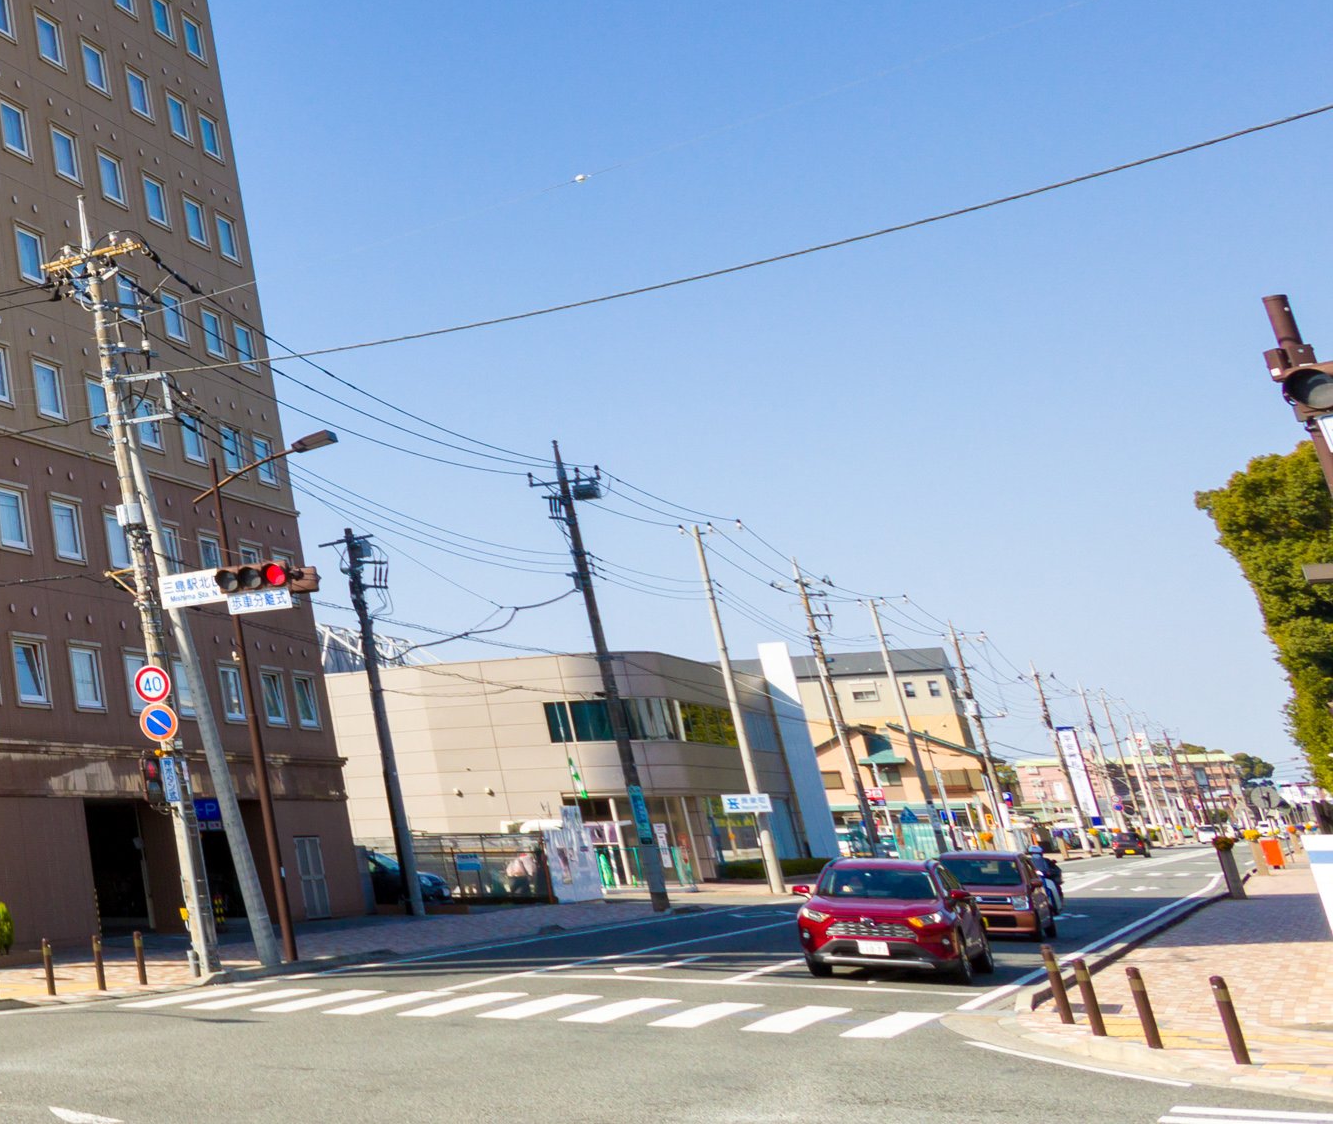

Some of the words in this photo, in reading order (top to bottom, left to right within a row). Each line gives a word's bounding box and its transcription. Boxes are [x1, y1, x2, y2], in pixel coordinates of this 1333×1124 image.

[233, 591, 288, 611] 歩車分離式
[144, 677, 163, 692] 40
